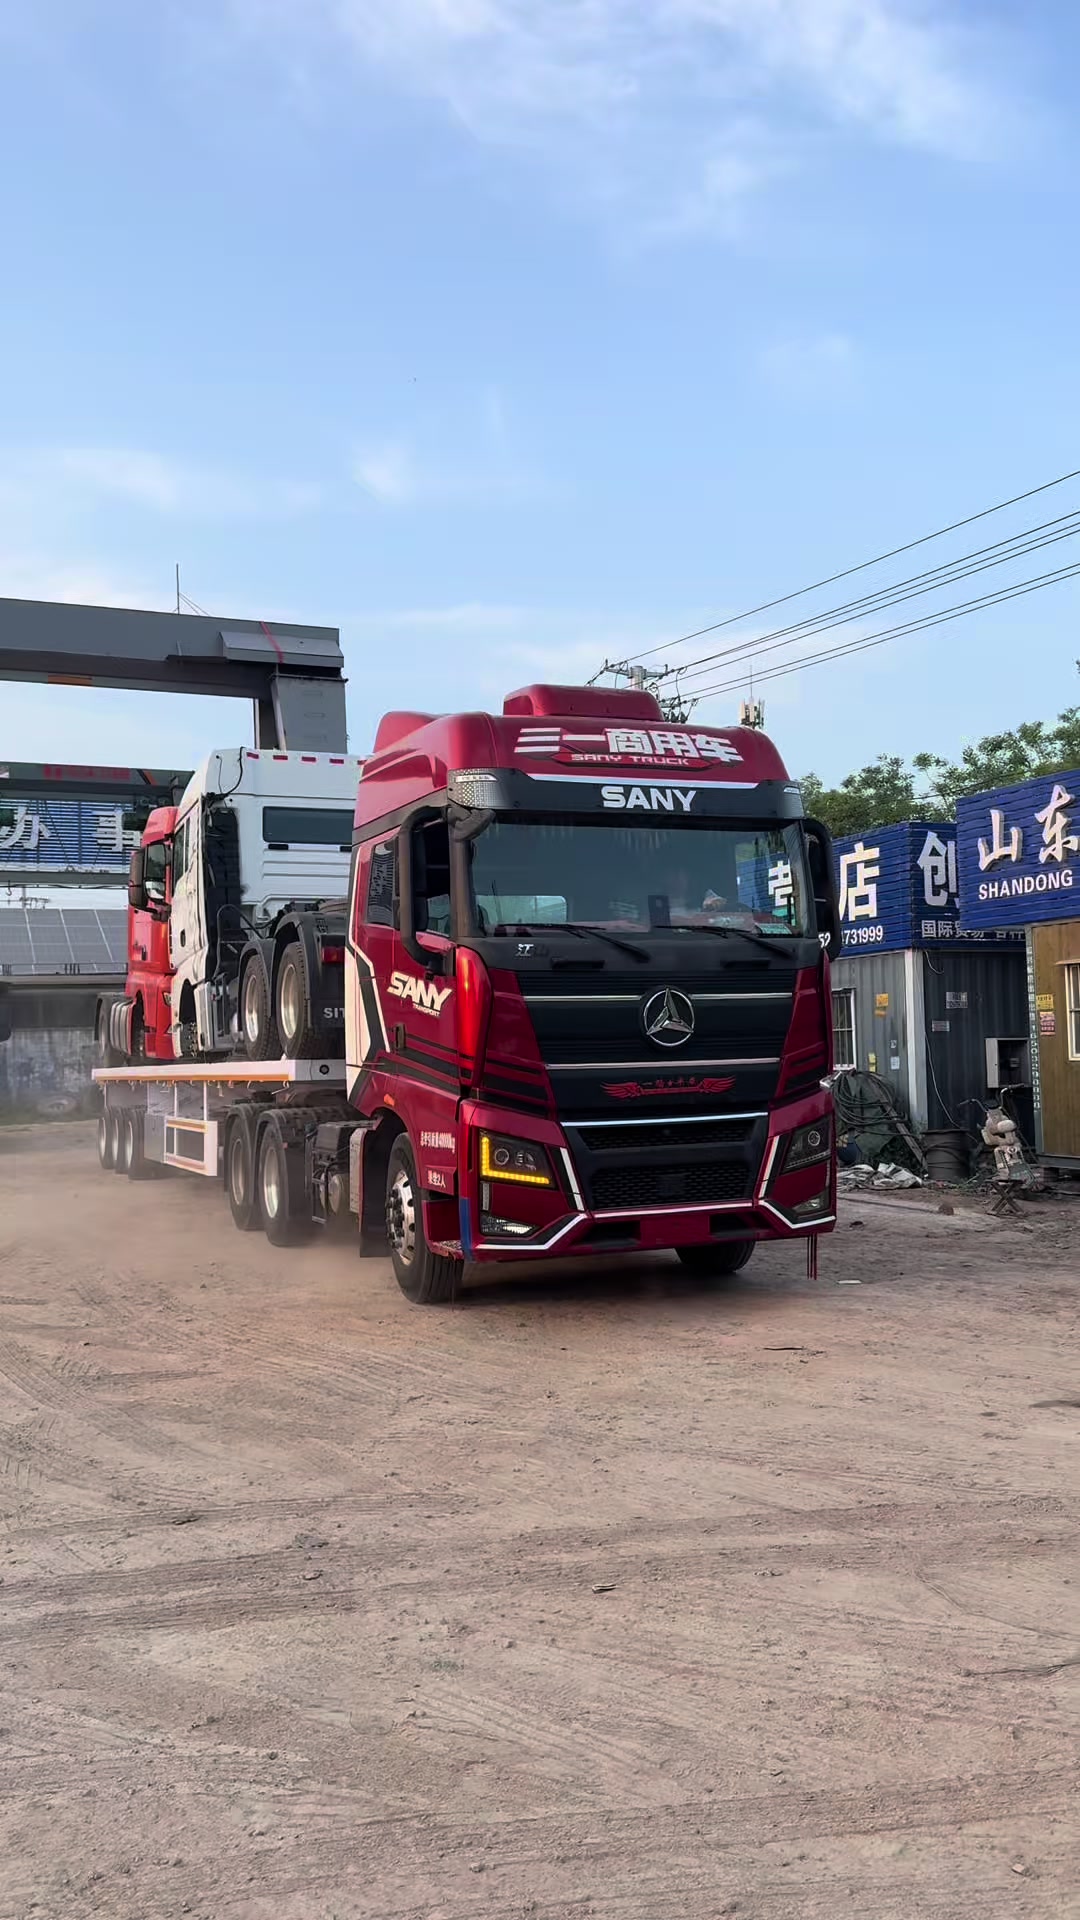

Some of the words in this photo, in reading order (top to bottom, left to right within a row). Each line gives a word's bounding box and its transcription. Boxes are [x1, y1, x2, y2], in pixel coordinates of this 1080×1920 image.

[514, 728, 744, 763] 三一商用车
[571, 753, 622, 764] SANY
[631, 756, 689, 766] TRUCK
[601, 786, 696, 812] SANY
[977, 785, 1080, 871] 山东
[978, 869, 1073, 900] SHANDONG
[387, 971, 452, 1011] SANY
